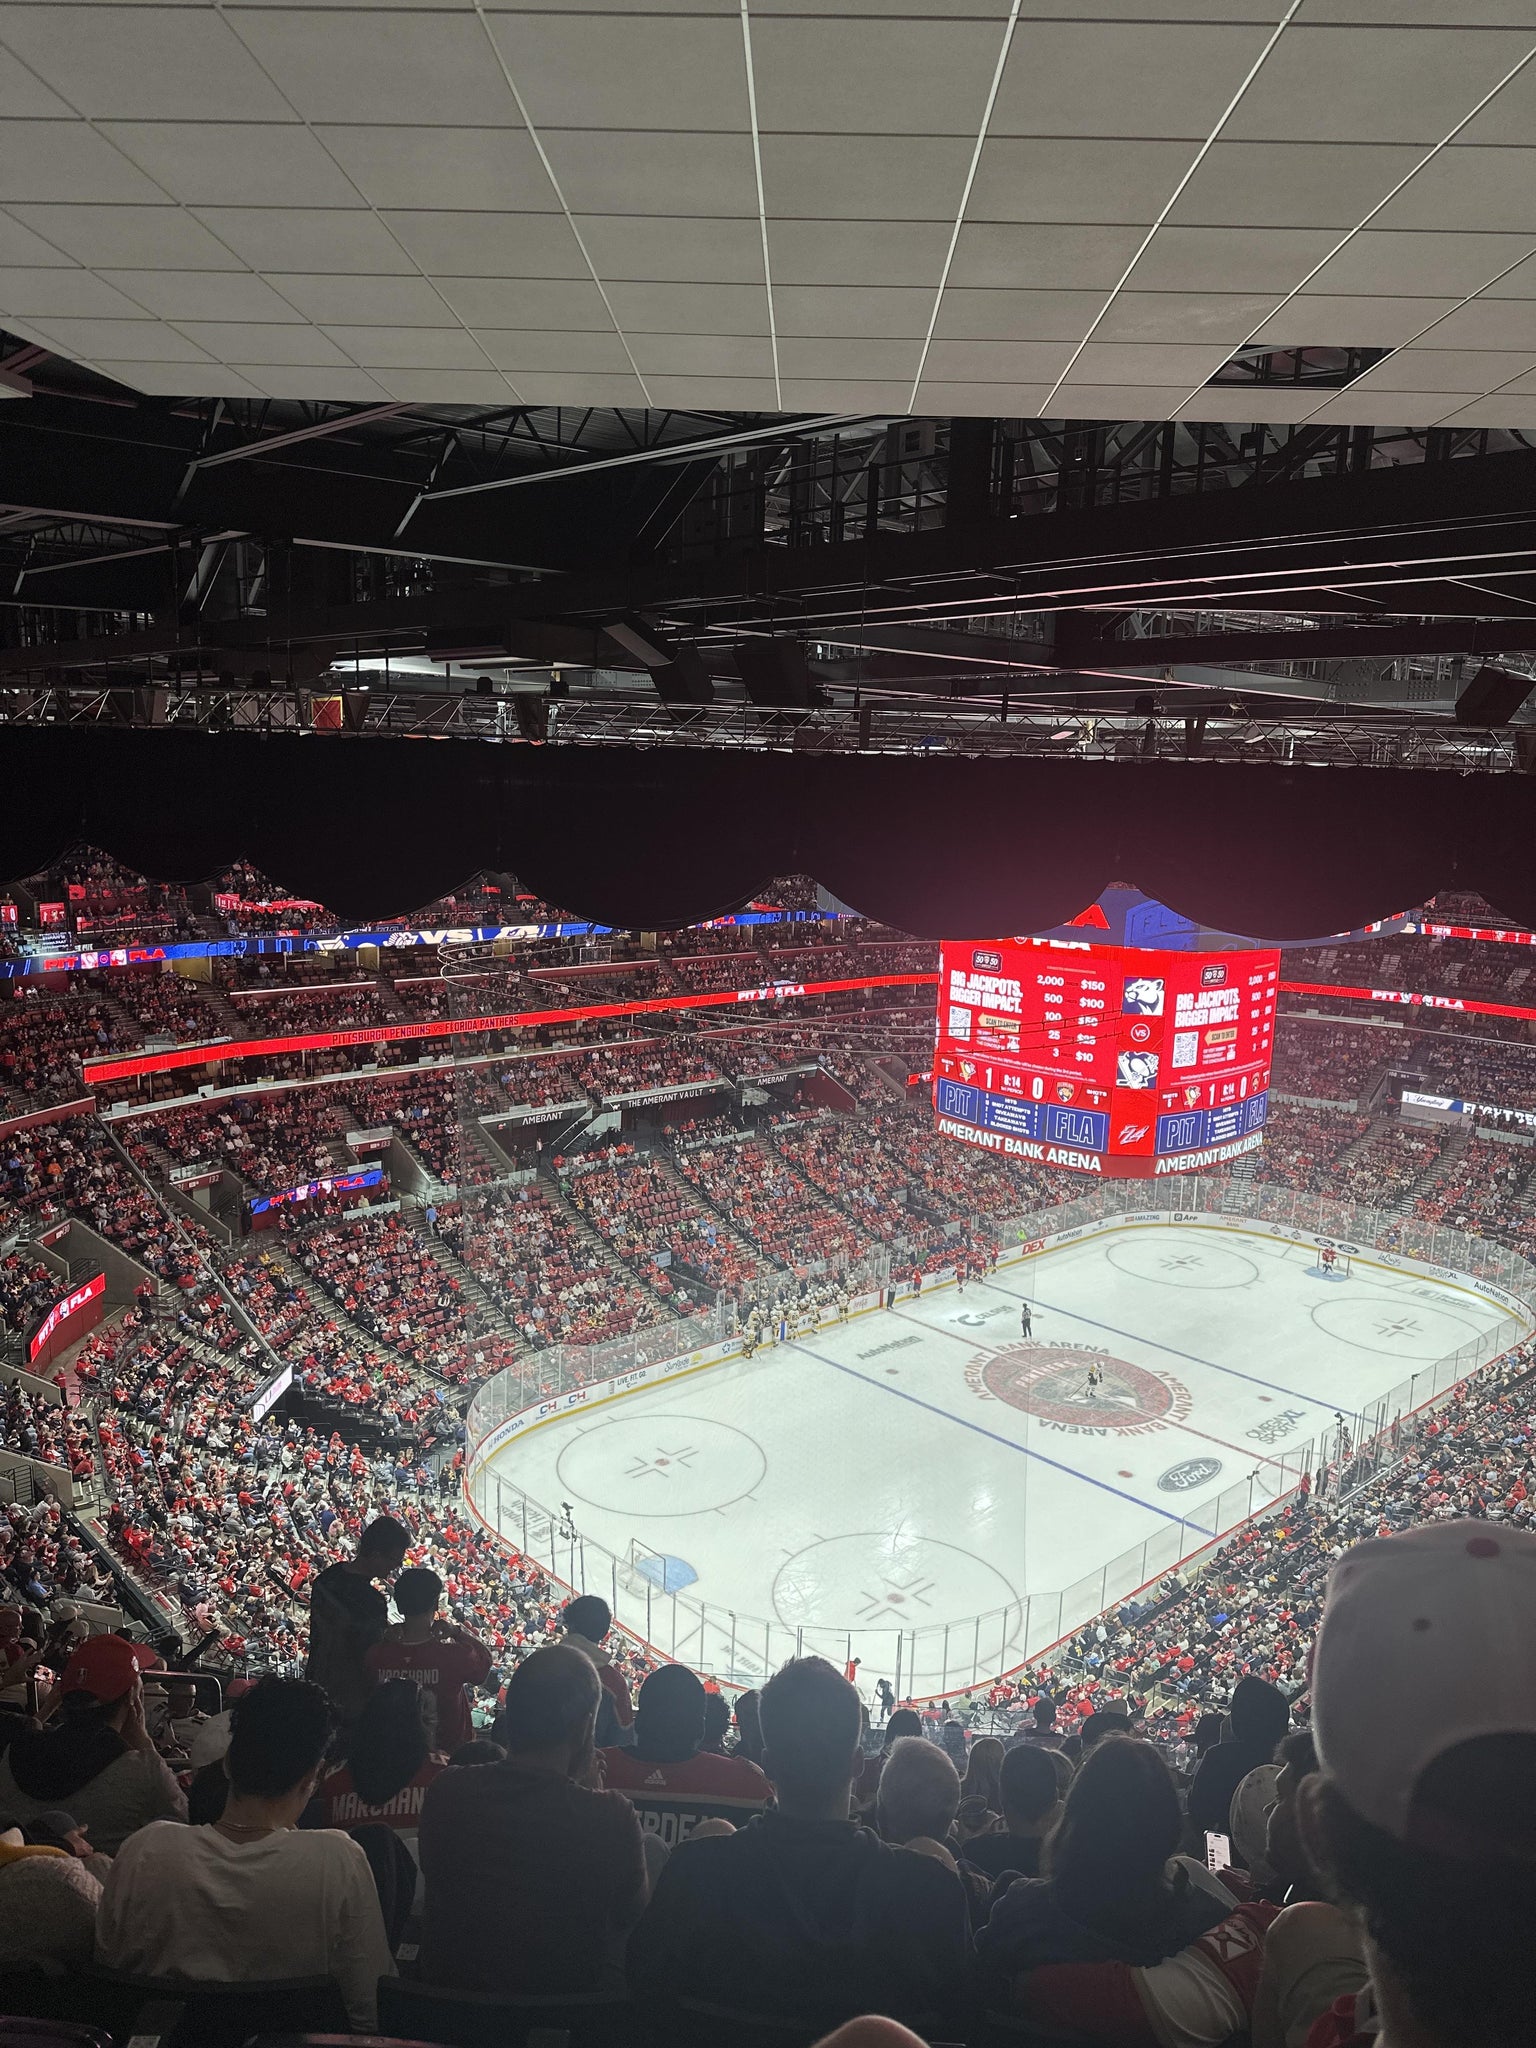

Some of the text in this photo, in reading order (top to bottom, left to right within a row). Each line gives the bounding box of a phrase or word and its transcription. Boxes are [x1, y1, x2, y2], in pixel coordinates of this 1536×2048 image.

[419, 929, 474, 945] VS
[129, 948, 166, 962] FLA
[738, 985, 805, 1001] PIT FLA
[951, 970, 1023, 997] BIG JACKPOTS.
[1036, 975, 1105, 991] 2,000 $150
[950, 986, 1022, 1013] BIGGER IMPACT.
[1044, 993, 1104, 1009] 500 $100
[1176, 988, 1240, 1011] BIG JACKPOTS.
[1372, 991, 1464, 1009] PIT FLA
[1045, 1011, 1061, 1021] 100
[1175, 1004, 1239, 1028] BIGGER IMPACT.
[333, 1030, 387, 1045] PITTSBURGH
[389, 1024, 431, 1040] PENGUINS
[445, 1019, 478, 1033] FLORIDA
[480, 1015, 519, 1029] PANTHERS
[1048, 1030, 1060, 1040] 25
[1135, 1029, 1147, 1037] VS
[1053, 1048, 1093, 1062] 3 $10
[757, 1074, 788, 1086] AMERANT
[985, 1067, 992, 1089] 1
[1004, 1074, 1021, 1088] 8:14
[1032, 1077, 1044, 1099] 0
[1240, 1076, 1247, 1098] 0
[628, 1088, 704, 1108] THE AMERANT VAULT
[945, 1085, 971, 1116] PIT
[1209, 1083, 1215, 1106] 1
[522, 1111, 564, 1125] AMERANT
[1056, 1111, 1094, 1145] FLA
[1167, 1117, 1195, 1147] PIT
[938, 1119, 1102, 1172] AMERANT BANK ARENA
[1154, 1131, 1263, 1174] AMERANT BANK ARENA
[334, 1177, 364, 1188] FLA
[1057, 1229, 1082, 1242] AutoNation
[1022, 1239, 1046, 1255] DEX
[71, 1287, 93, 1309] FLA
[1474, 1281, 1509, 1303] AutoNation
[856, 1336, 923, 1360] AutoNation
[996, 1341, 1110, 1354] BANK ARENA
[964, 1352, 997, 1400] AMERANT
[1016, 1360, 1079, 1388] PANTHERS
[569, 1391, 586, 1403] CH
[1152, 1370, 1193, 1421] AMERANT
[540, 1401, 557, 1414] CH
[493, 1419, 524, 1444] HONDA
[1040, 1418, 1168, 1437] BANK ARENA
[1258, 1424, 1298, 1445] SPORT
[1169, 1463, 1213, 1488] Ford
